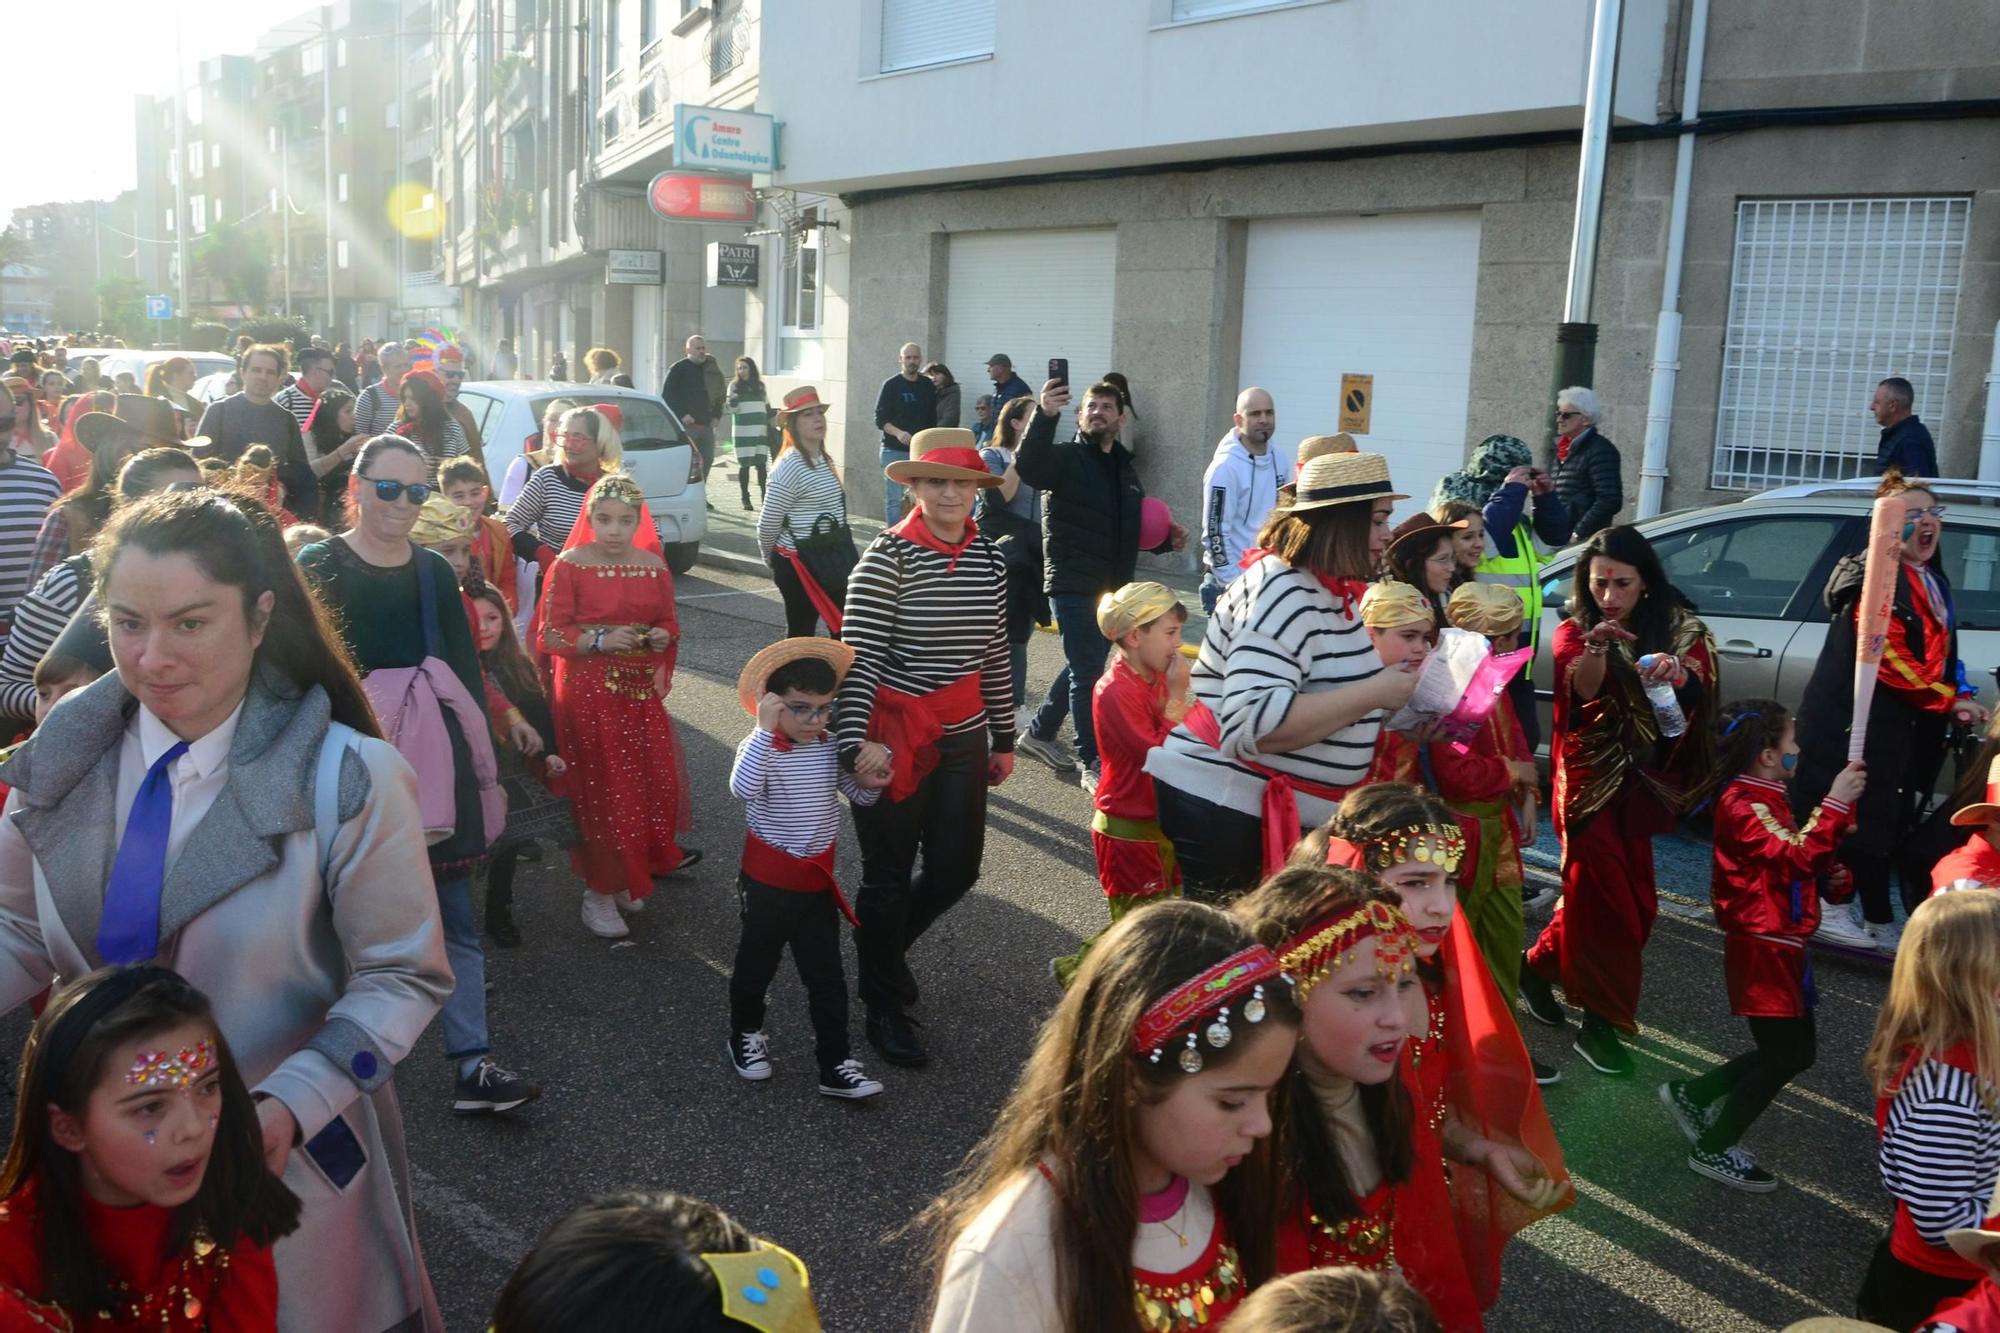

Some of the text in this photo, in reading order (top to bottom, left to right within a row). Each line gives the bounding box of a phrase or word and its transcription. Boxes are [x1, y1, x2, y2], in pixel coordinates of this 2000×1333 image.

[712, 122, 741, 135] Amaro
[712, 134, 740, 147] Centro
[719, 244, 756, 259] PATRI
[152, 299, 165, 316] P
